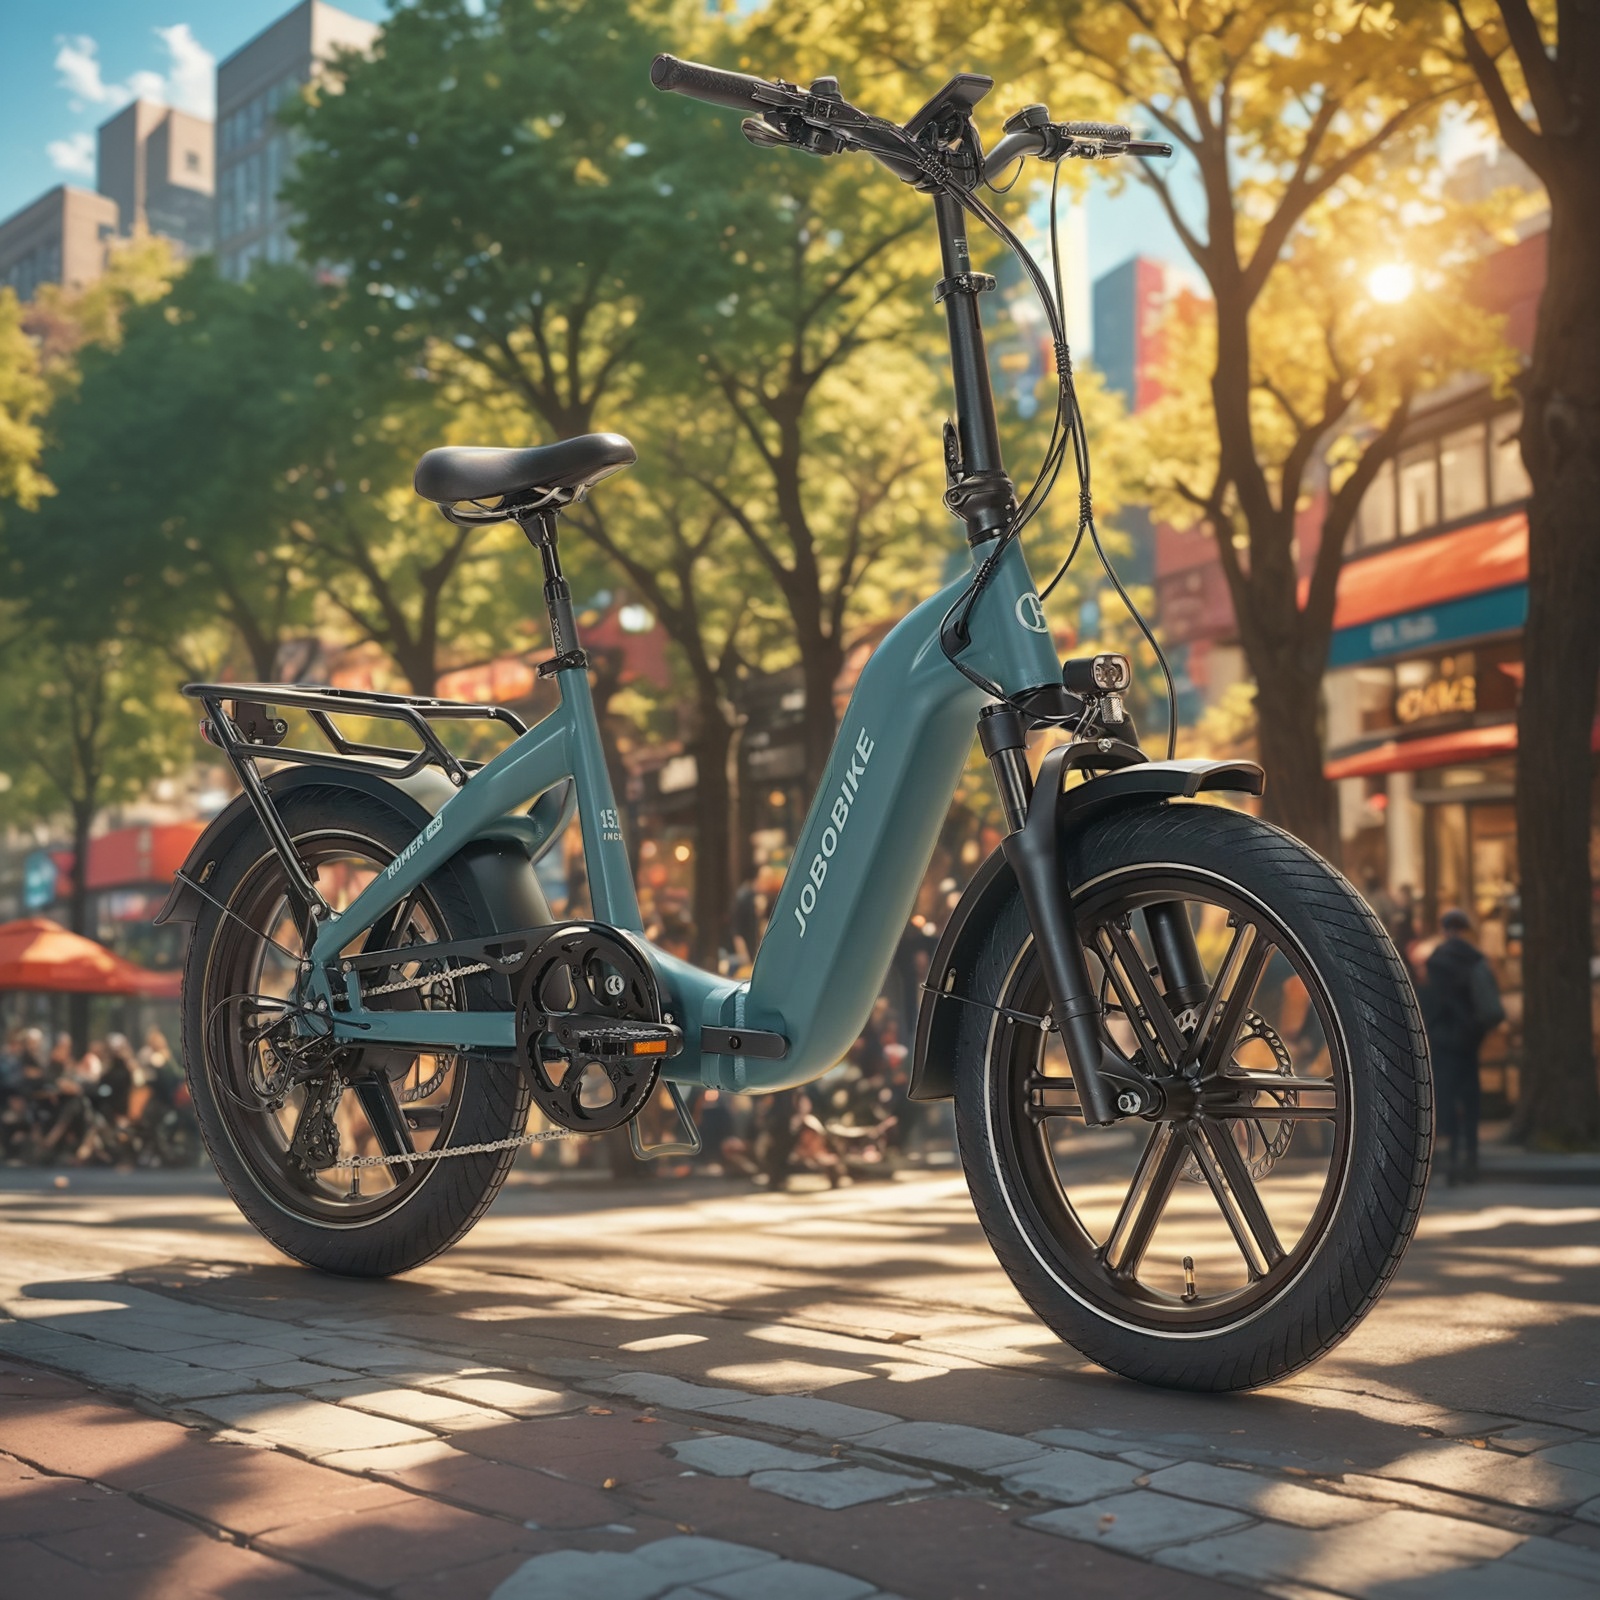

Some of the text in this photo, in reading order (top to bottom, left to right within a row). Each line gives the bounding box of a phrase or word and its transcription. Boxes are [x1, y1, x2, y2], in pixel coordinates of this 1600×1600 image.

[387, 818, 442, 880] ROMER PRO
[794, 727, 875, 938] JOBOBIKE
